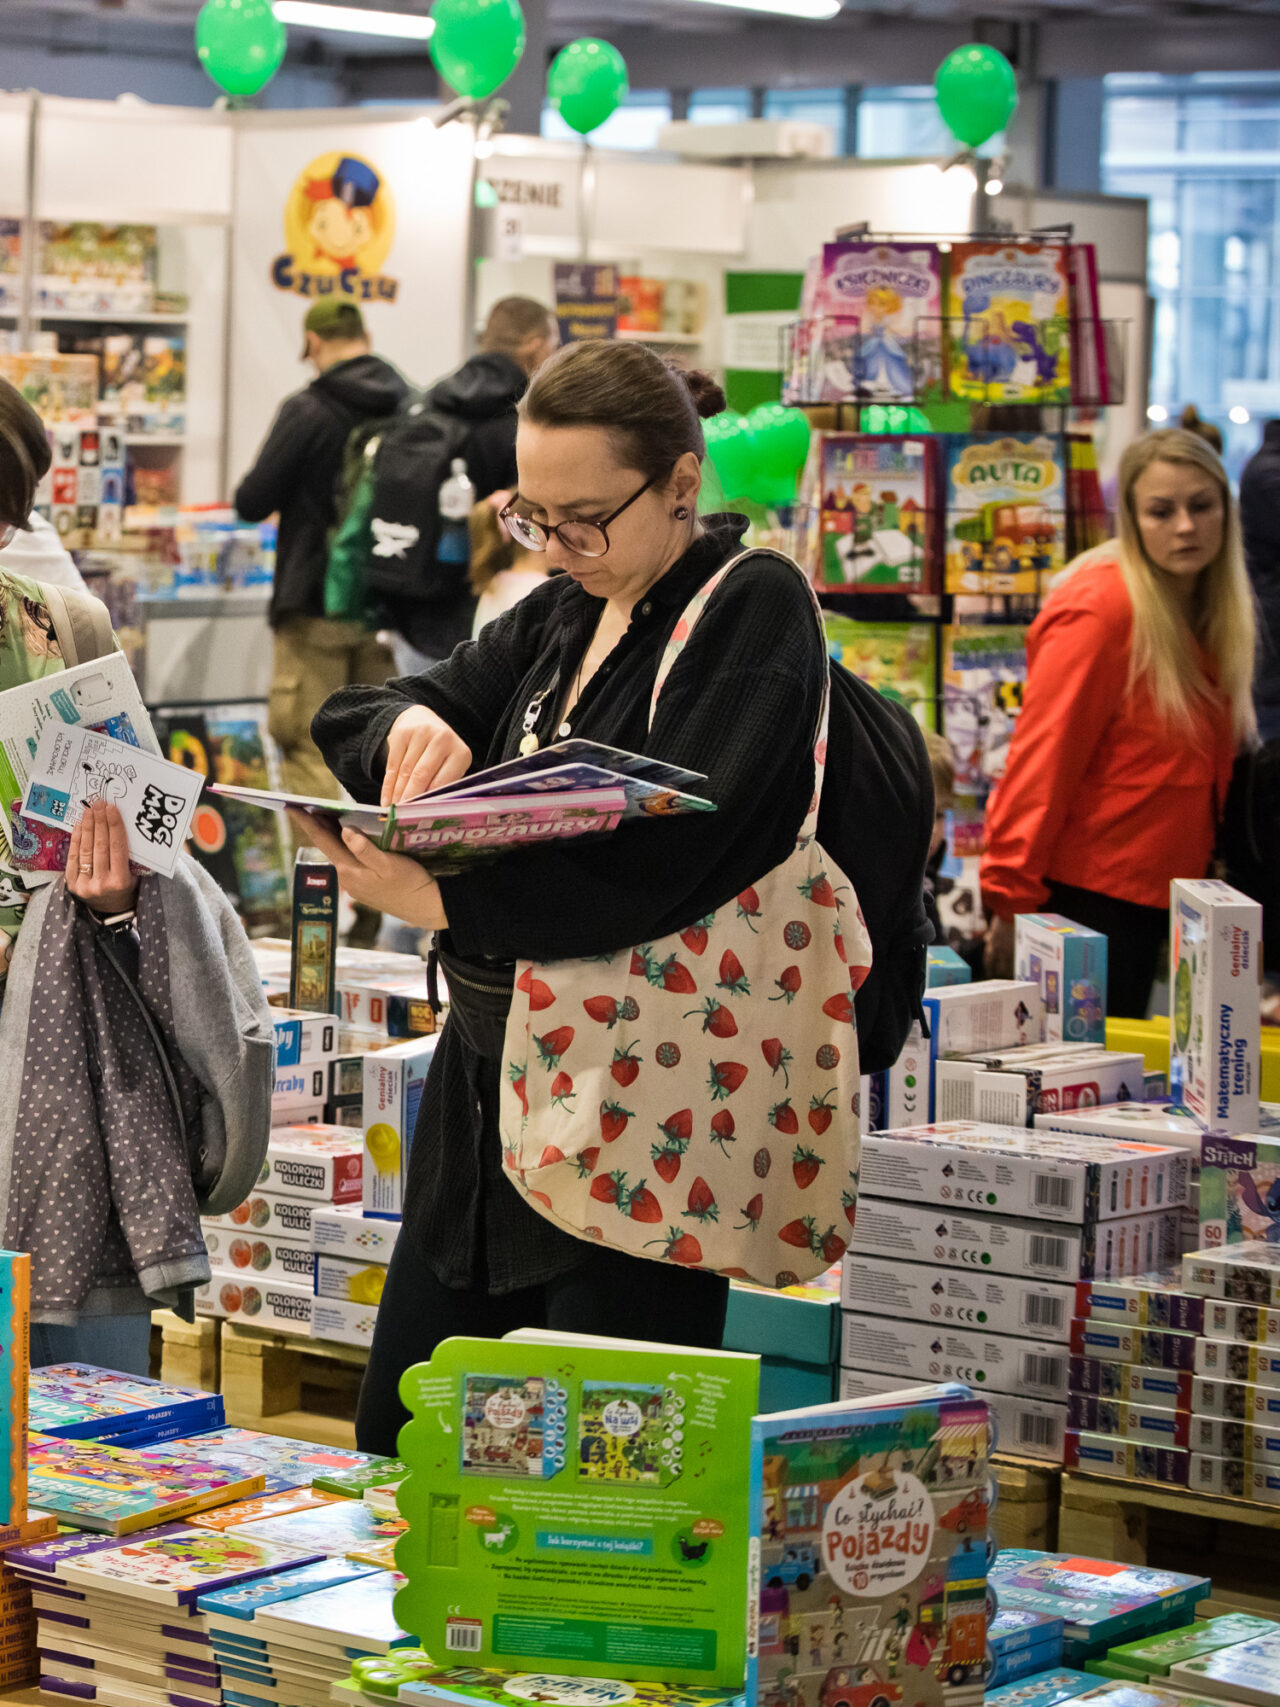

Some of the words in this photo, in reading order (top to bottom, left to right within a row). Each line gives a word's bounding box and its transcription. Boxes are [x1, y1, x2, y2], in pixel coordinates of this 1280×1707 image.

[272, 255, 398, 304] CzuCzu
[970, 462, 1042, 484] AUTA
[135, 783, 167, 843] MAN
[154, 793, 186, 848] DOG
[408, 818, 599, 845] DINOZAURY
[1231, 926, 1242, 977] Genialny
[1241, 930, 1249, 970] dzieciak
[1217, 1004, 1234, 1119] Matematyczny
[1234, 1038, 1247, 1096] trening
[378, 1066, 387, 1110] Genialny
[275, 1160, 324, 1179] KOLOROWE
[282, 1173, 324, 1189] KULECZKI
[1204, 1224, 1221, 1239] 60
[147, 1410, 172, 1421] POJAZDY
[157, 1427, 179, 1438] POJAZDY
[835, 1506, 854, 1526] Co
[547, 1535, 559, 1545] Jak
[560, 1536, 596, 1549] korzystać
[603, 1539, 613, 1551] tej
[614, 1540, 644, 1552] książki?
[826, 1521, 930, 1562] Pojazdy
